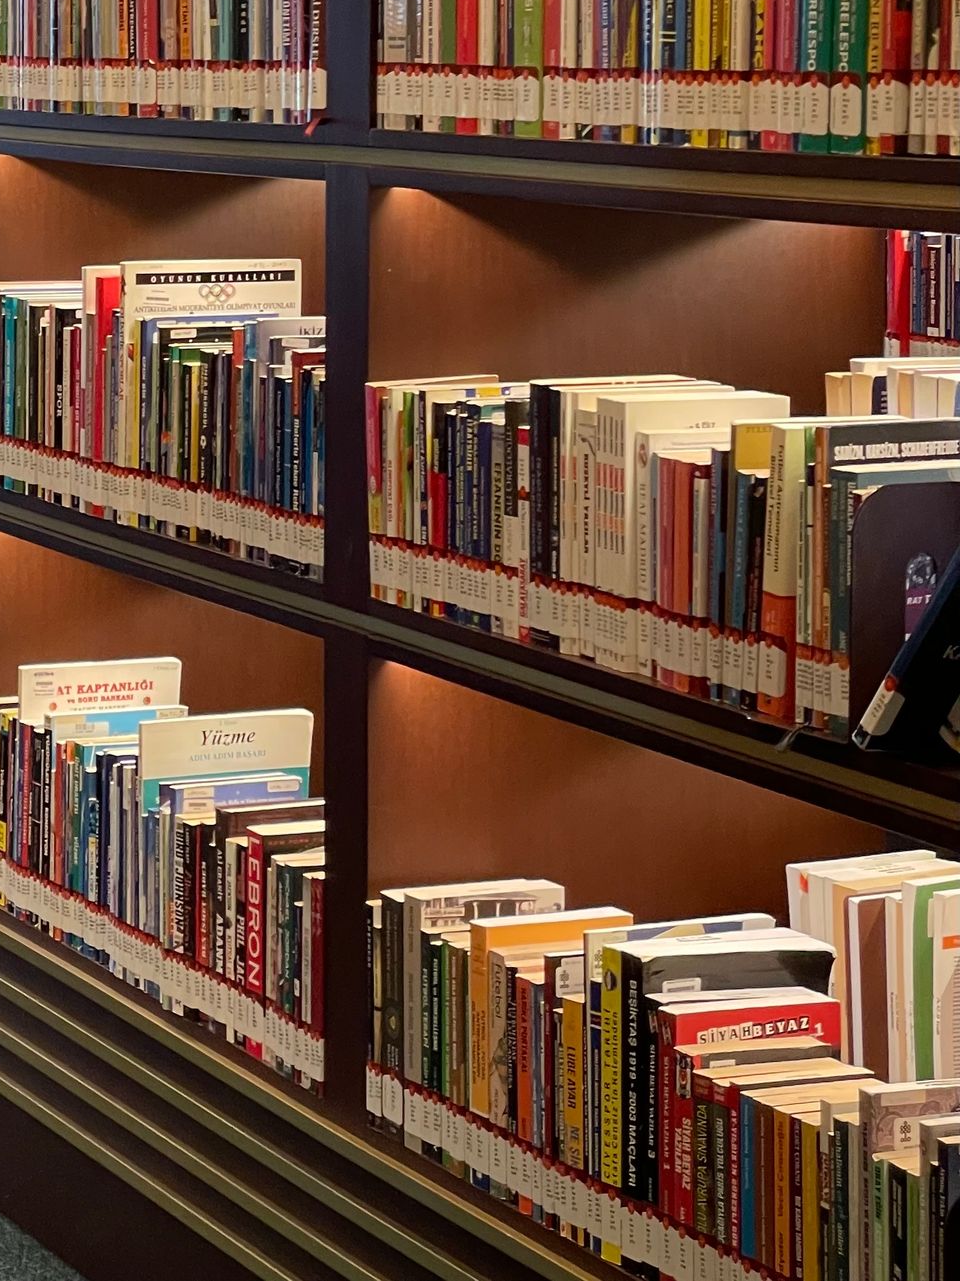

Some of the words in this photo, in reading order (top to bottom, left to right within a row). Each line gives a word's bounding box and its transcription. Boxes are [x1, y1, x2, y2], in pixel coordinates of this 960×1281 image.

[150, 275, 202, 283] OYUNUN
[211, 273, 282, 282] KURALLARI
[773, 444, 784, 482] Futbol
[494, 462, 502, 542] EFSANENİN
[76, 679, 154, 695] KAPTANLIĞI
[100, 694, 134, 702] BANKASI
[200, 729, 256, 747] Yüzme
[189, 753, 211, 762] ADIM
[213, 751, 234, 761] ADIM
[235, 749, 267, 759] BAŞARI
[248, 836, 260, 985] LEBRON
[236, 914, 245, 948] PHIL
[627, 980, 638, 1046] BEŞİKTAŞ
[627, 1051, 638, 1080] 1919
[648, 1075, 656, 1105] BEYAZ
[627, 1090, 638, 1121] 2003
[627, 1124, 638, 1187] MAÇLARI
[648, 1149, 656, 1158] 3
[663, 1162, 670, 1170] 1
[697, 1166, 708, 1209] AVRUPA
[716, 1171, 725, 1199] PARİS
